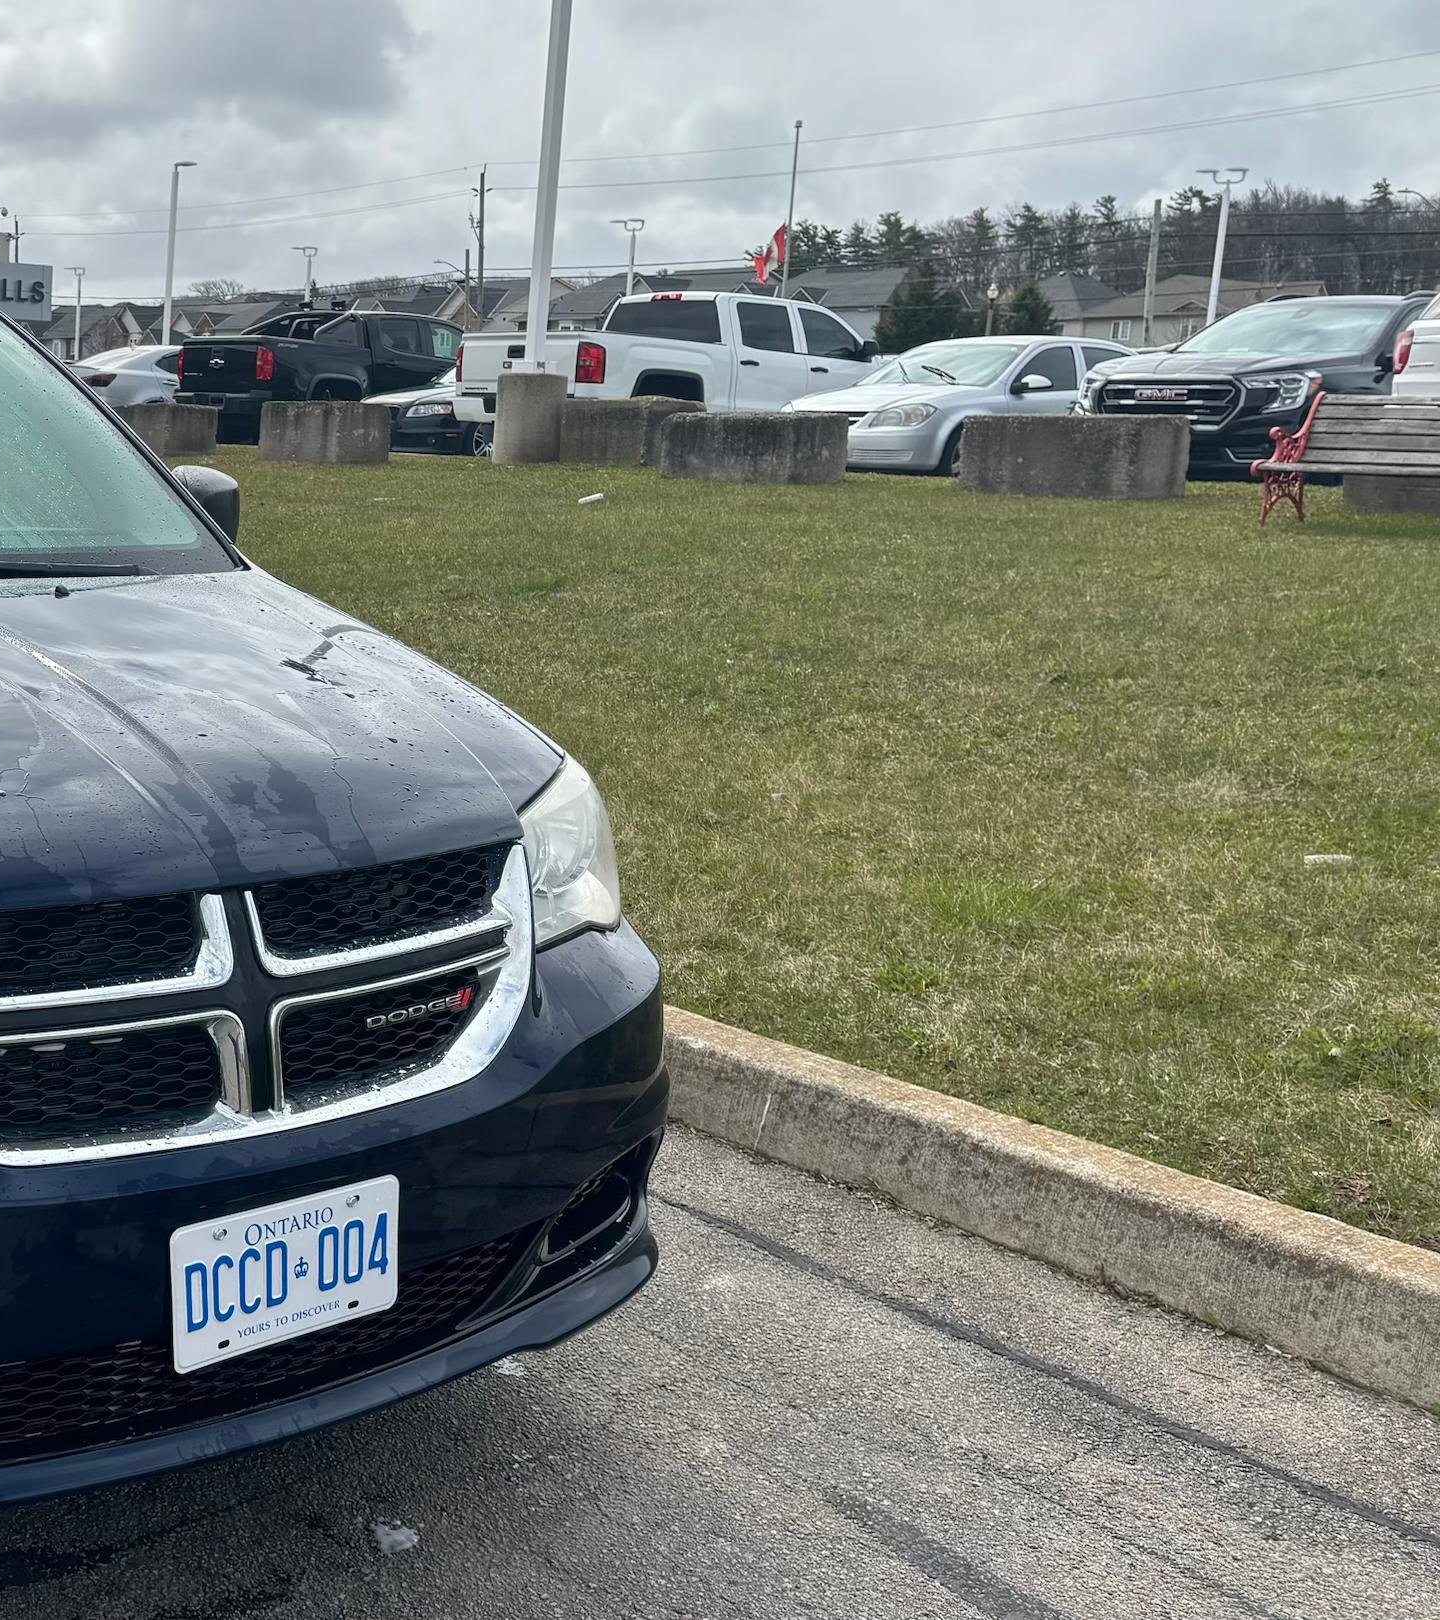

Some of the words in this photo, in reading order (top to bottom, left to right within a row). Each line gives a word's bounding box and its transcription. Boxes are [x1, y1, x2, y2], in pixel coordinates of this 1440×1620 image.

[1134, 389, 1188, 401] GMC
[366, 992, 462, 1030] DODGE
[244, 1206, 333, 1246] ONTARIO
[184, 1239, 289, 1334] DCCD
[317, 1211, 389, 1293] 004
[236, 1320, 271, 1339] YOURS
[275, 1315, 289, 1328] TO
[291, 1299, 341, 1323] DISCOVER
